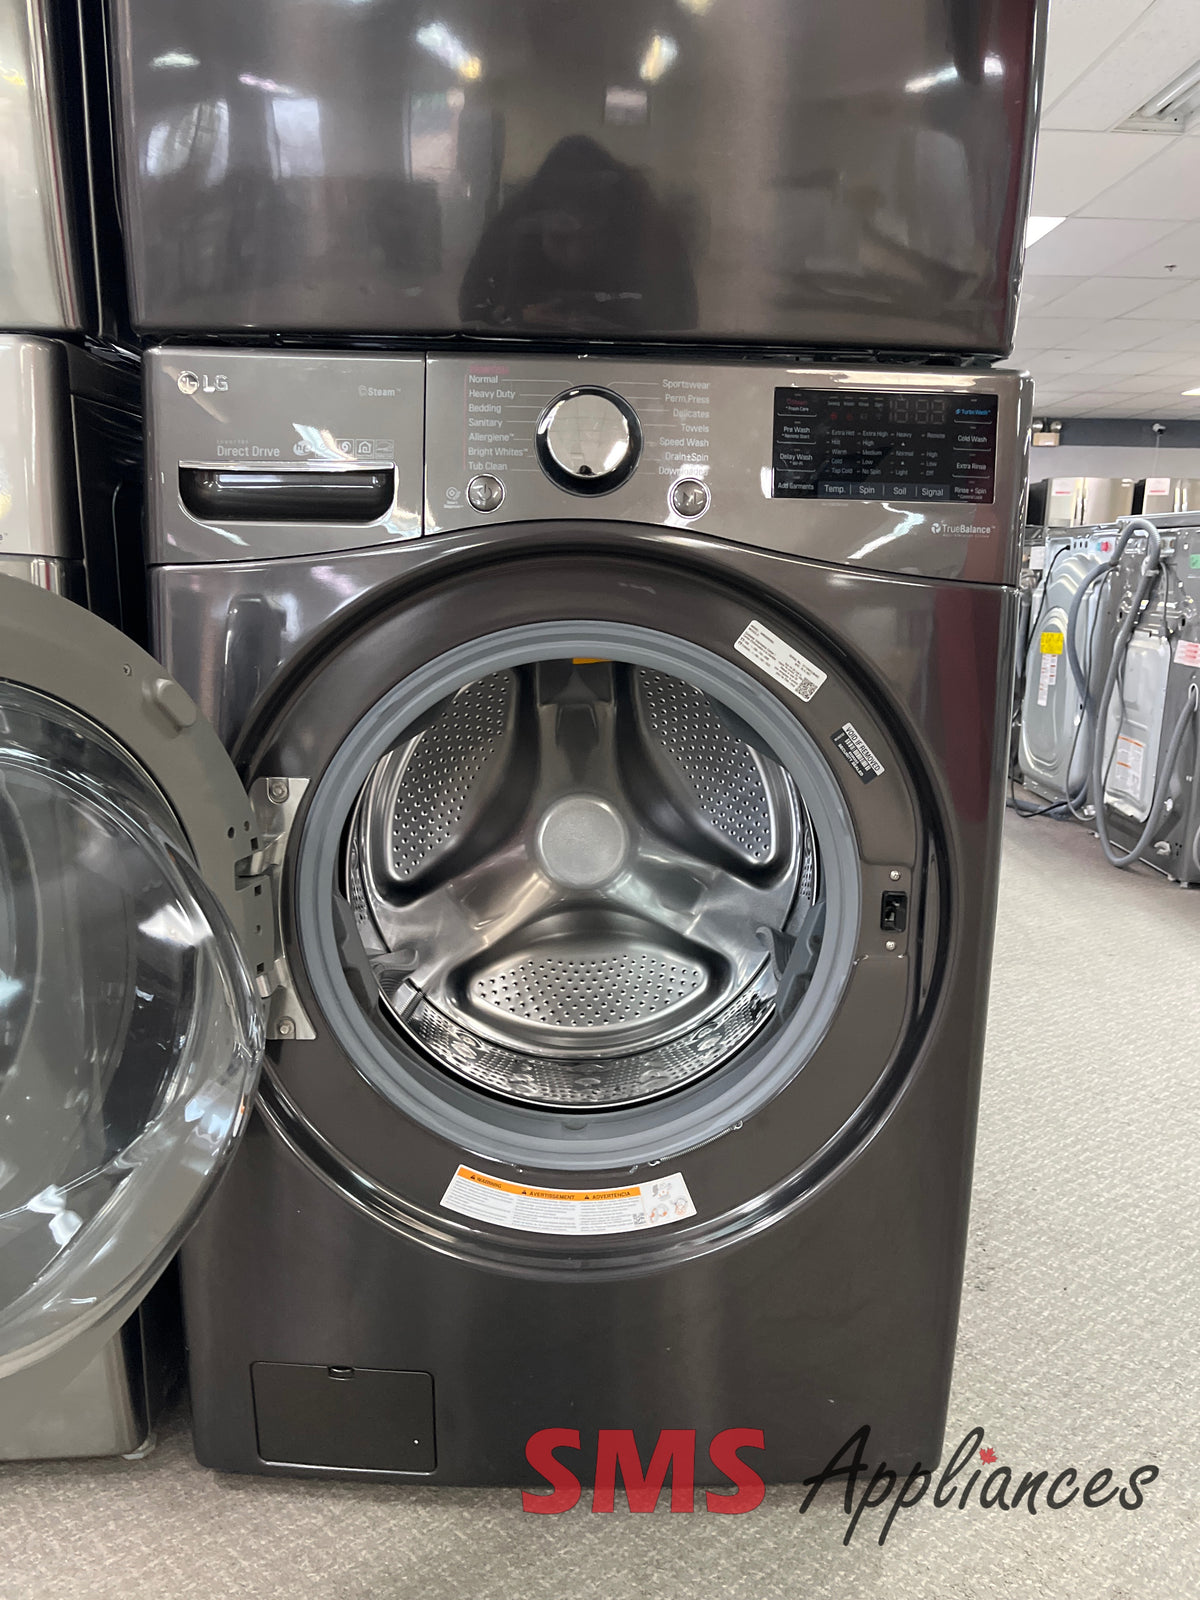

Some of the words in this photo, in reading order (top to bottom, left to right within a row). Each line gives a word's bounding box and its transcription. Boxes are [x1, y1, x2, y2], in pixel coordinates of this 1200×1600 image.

[203, 375, 229, 392] LG
[469, 375, 498, 385] Normal
[662, 379, 710, 390] Sportswear
[468, 389, 494, 400] Heavy
[496, 390, 515, 400] Duty
[468, 404, 501, 414] Bedding
[673, 409, 710, 419] Delicates
[468, 418, 502, 428] Sanitary
[681, 423, 709, 433] Towels
[660, 437, 684, 447] Speed
[686, 438, 709, 447] Wash
[217, 446, 250, 457] Direct
[252, 446, 280, 458] Drive
[468, 447, 492, 458] Bright
[468, 462, 483, 471] Tub
[484, 462, 507, 471] Clean
[824, 484, 846, 494] Temp.
[859, 486, 875, 495] Spin
[893, 487, 906, 495] Soil
[922, 488, 944, 497] Signal
[974, 487, 987, 495] Spin
[845, 726, 858, 742] VOID
[859, 744, 881, 772] REMOVED
